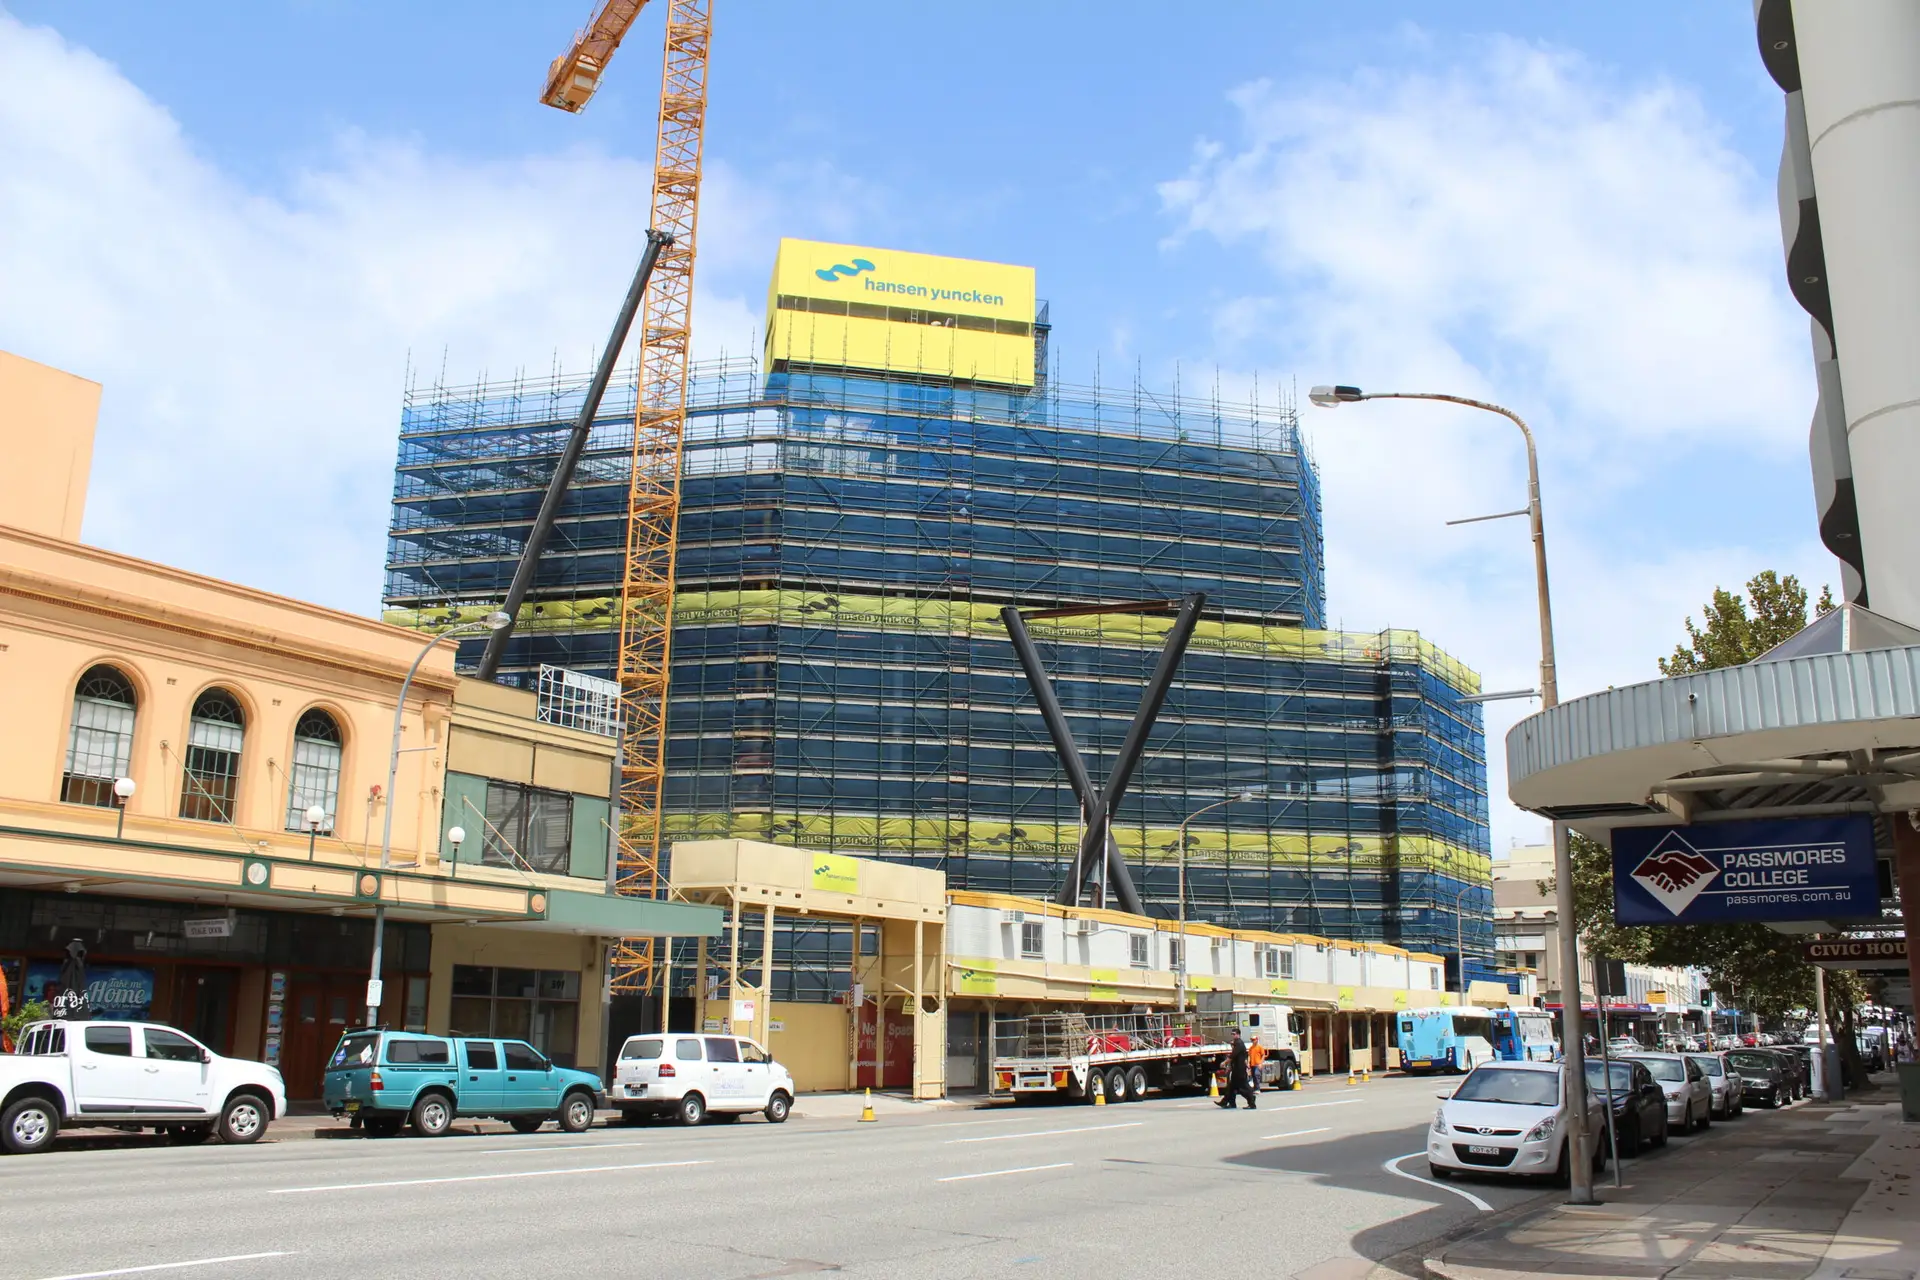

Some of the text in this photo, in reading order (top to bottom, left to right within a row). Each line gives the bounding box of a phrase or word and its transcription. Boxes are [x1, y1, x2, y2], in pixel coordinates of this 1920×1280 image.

[865, 277, 1004, 306] hansen yuncken
[566, 671, 620, 695] CIVIC
[1723, 848, 1846, 869] PASSMORES
[1724, 869, 1809, 888] COLLEGE
[1726, 890, 1851, 907] passmores.com.au
[1810, 941, 1908, 957] CIVIC HOU
[89, 980, 145, 1004] Home
[862, 1021, 914, 1038] Ne Spac
